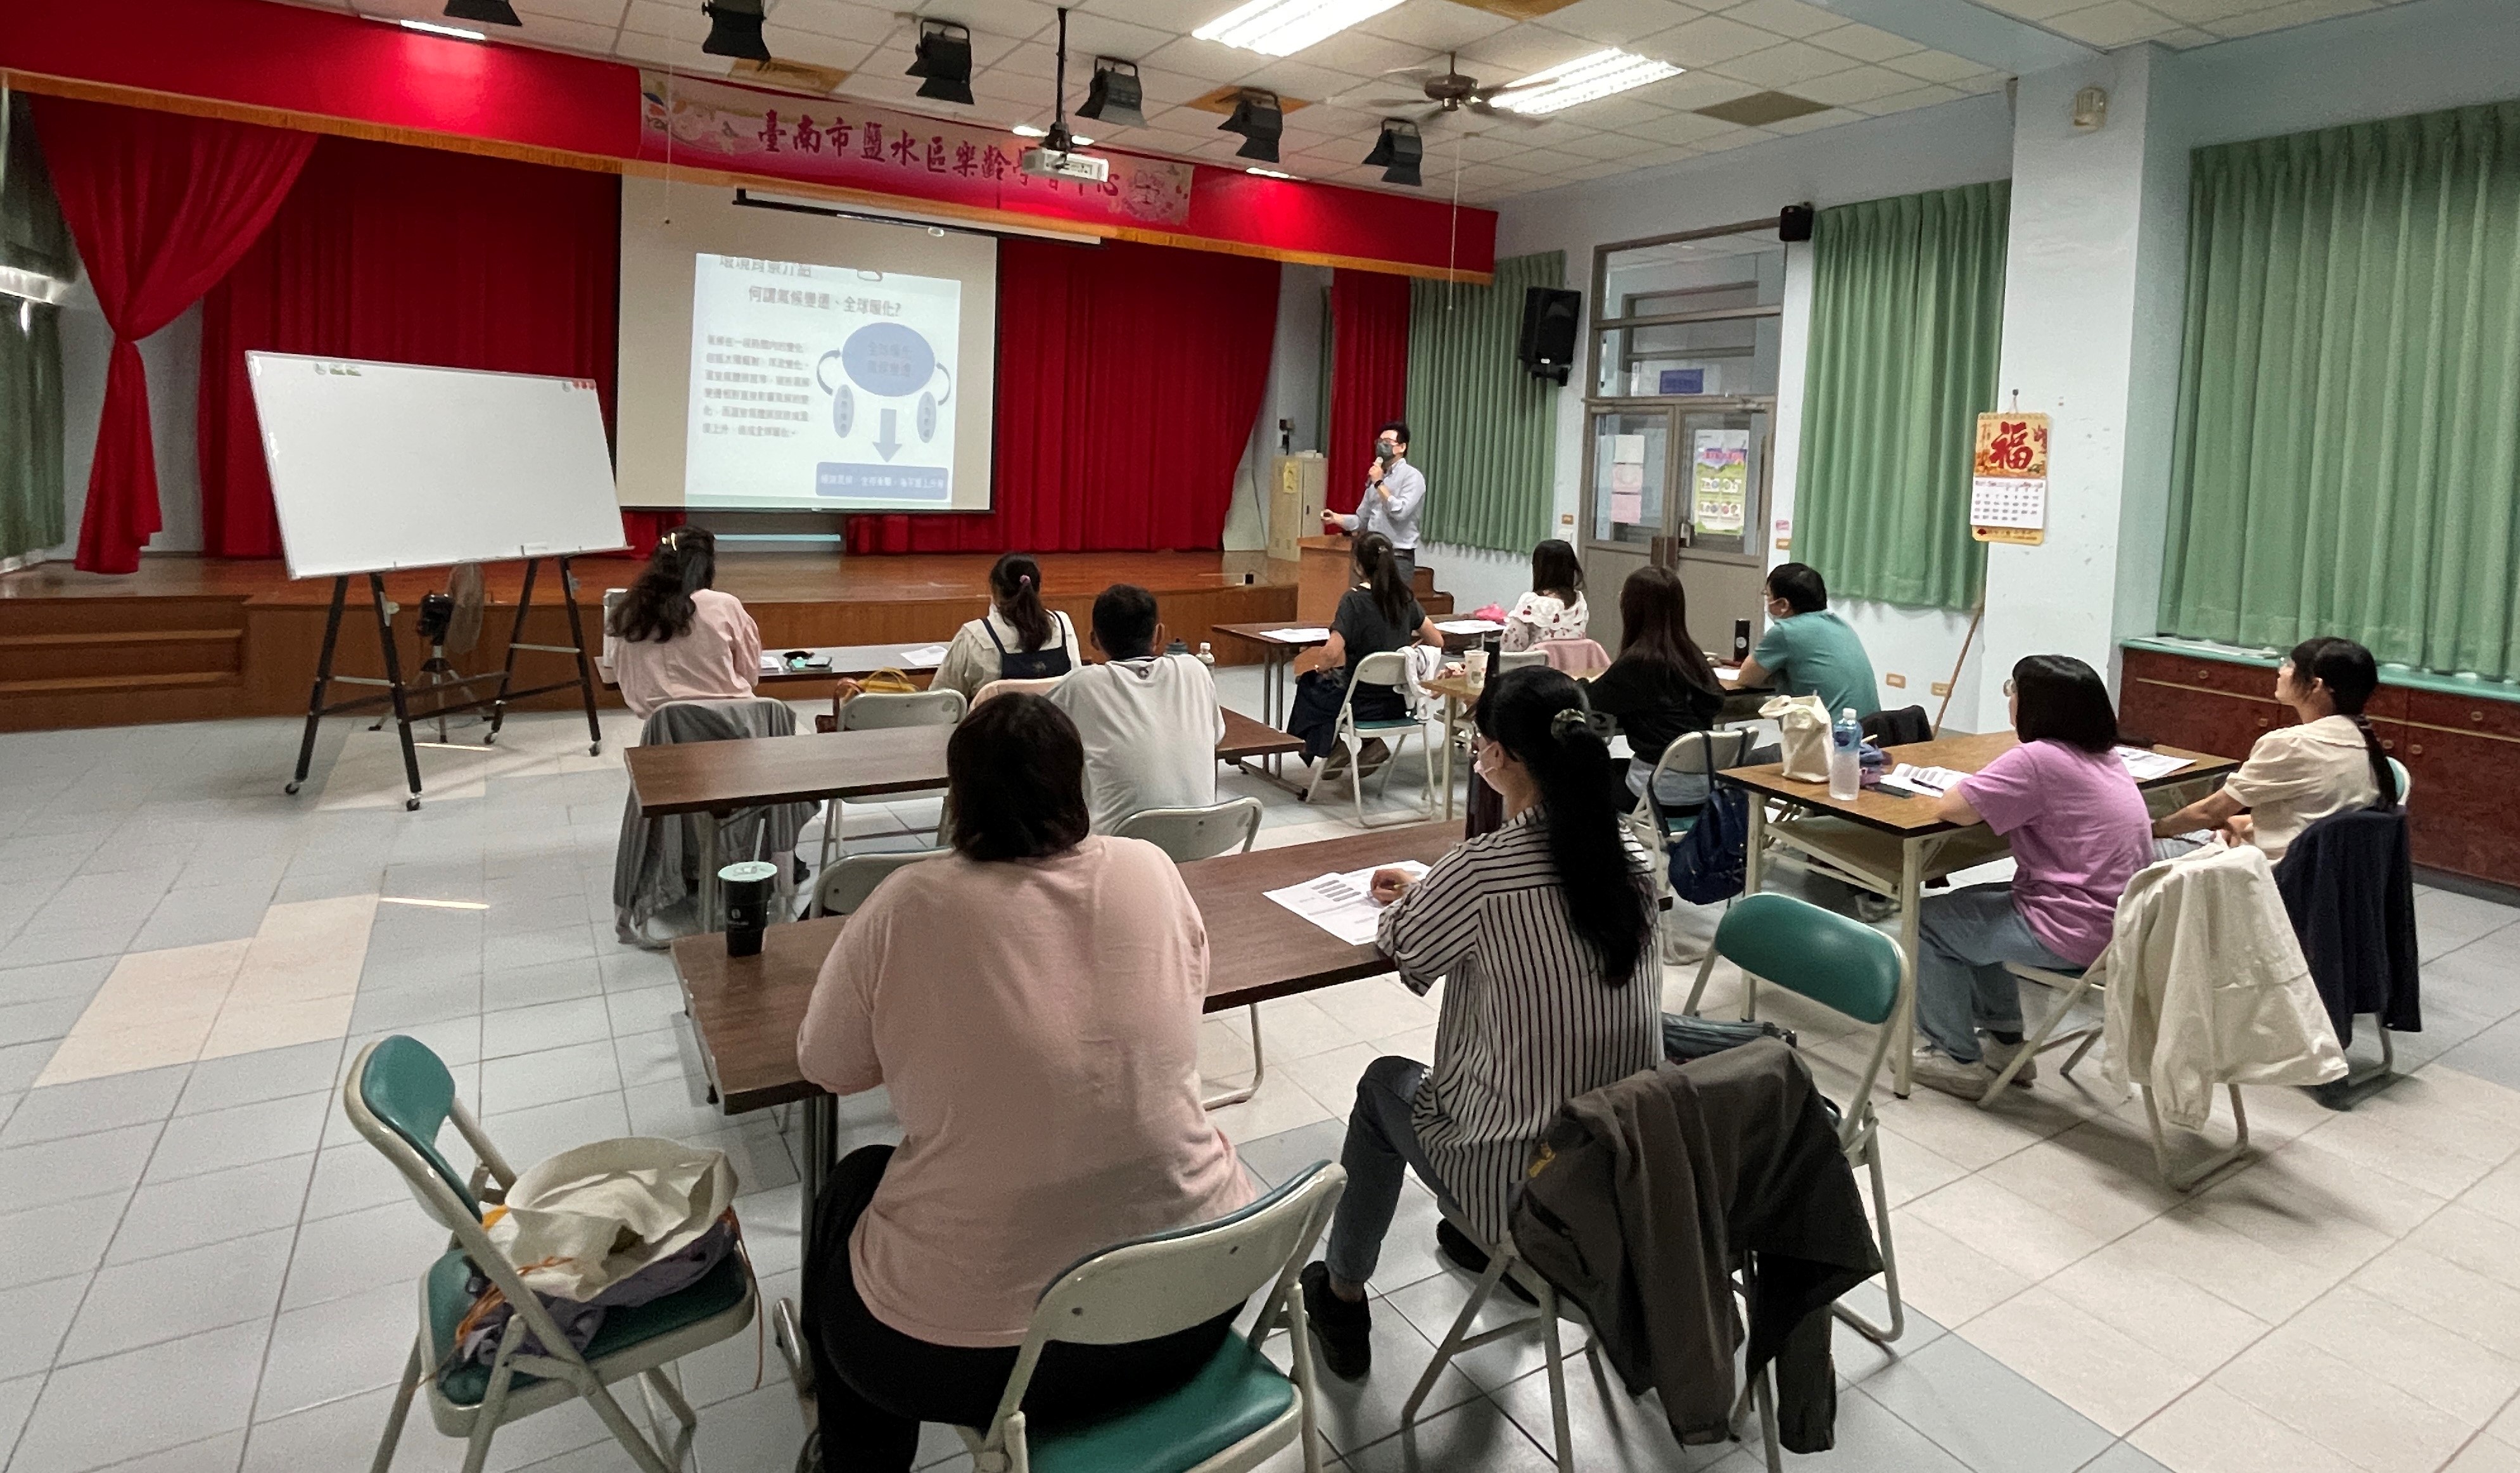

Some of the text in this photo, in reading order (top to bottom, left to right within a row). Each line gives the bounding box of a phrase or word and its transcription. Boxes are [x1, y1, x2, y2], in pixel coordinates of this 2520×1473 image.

[758, 109, 1120, 197] 臺南市鹽水區樂齡心
[1989, 421, 2033, 470] 福
